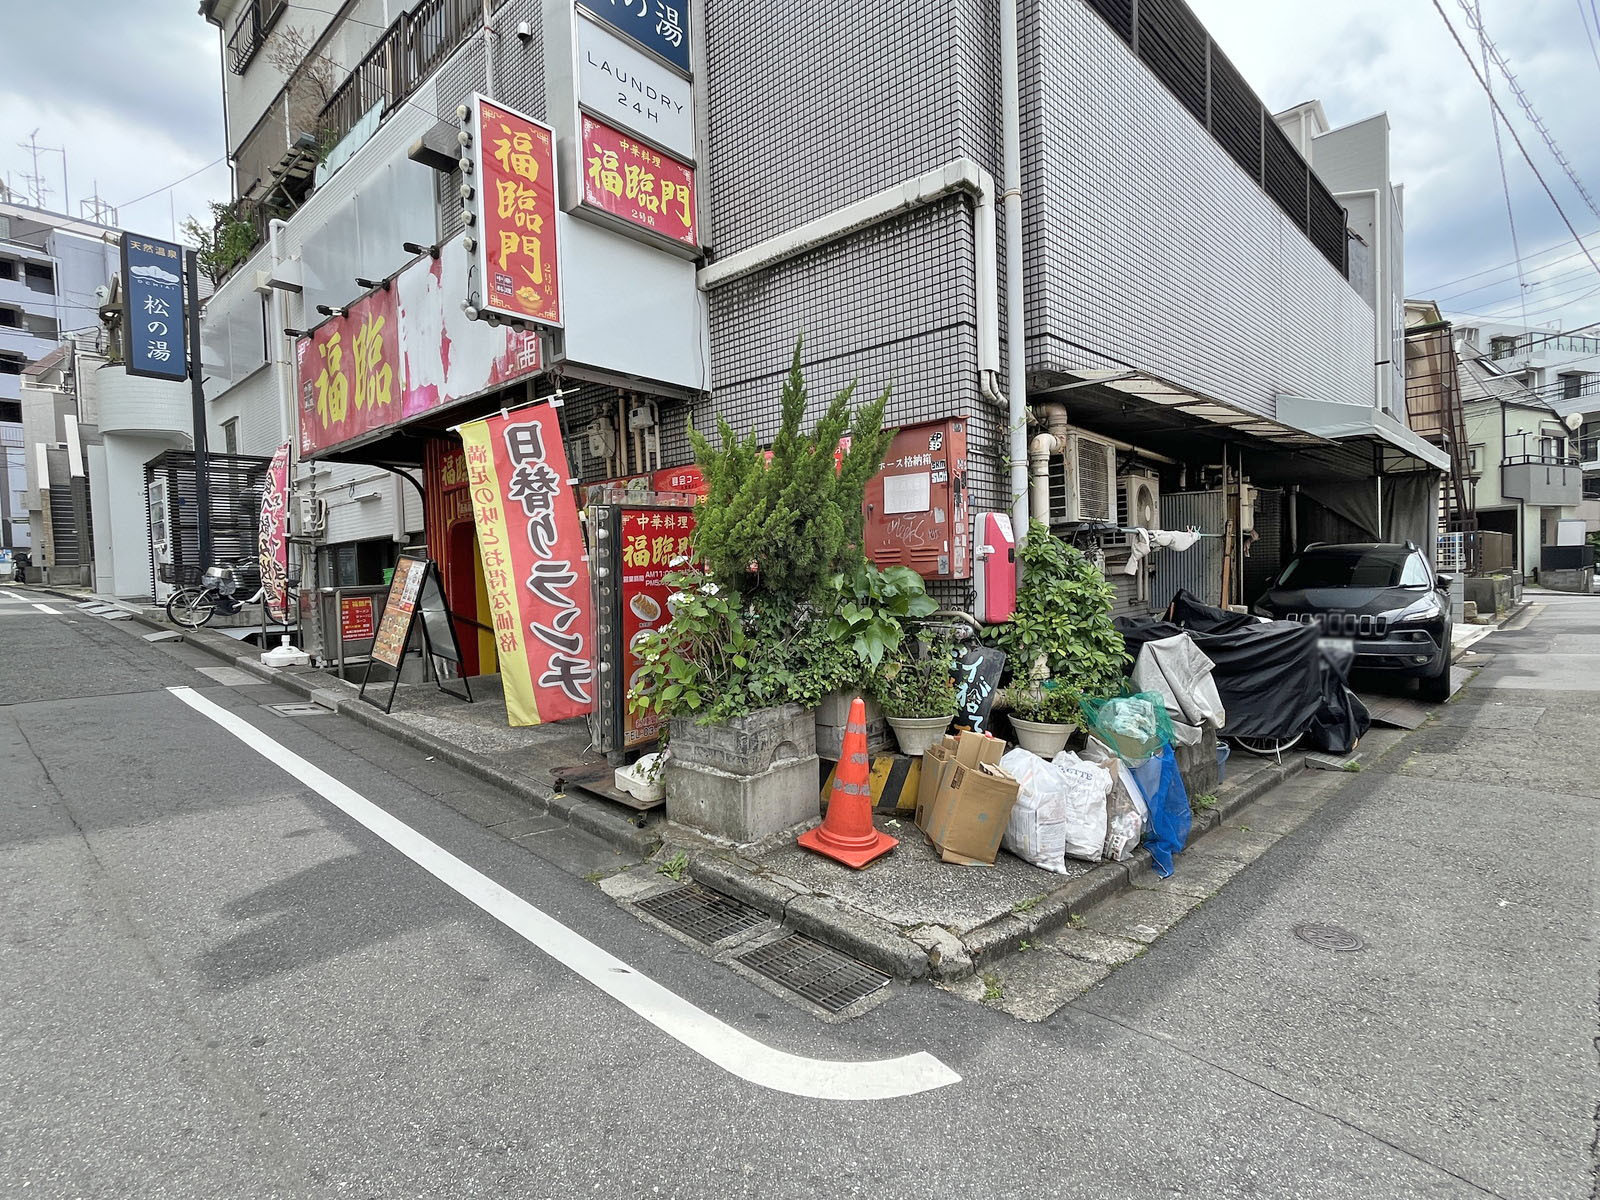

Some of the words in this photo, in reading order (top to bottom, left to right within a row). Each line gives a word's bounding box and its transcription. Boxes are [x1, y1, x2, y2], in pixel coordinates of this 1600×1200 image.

[610, 0, 683, 47] の湯
[587, 50, 684, 115] LAUNDRY
[617, 92, 658, 123] 24H
[619, 138, 661, 169] 中華料理
[492, 123, 543, 285] 福臨門
[587, 142, 692, 228] 福臨門
[631, 208, 655, 226] 2号店
[130, 240, 178, 260] 天然温泉
[143, 294, 171, 362] 松の湯
[637, 513, 688, 531] 中華料理
[953, 649, 992, 734] イ捨て
